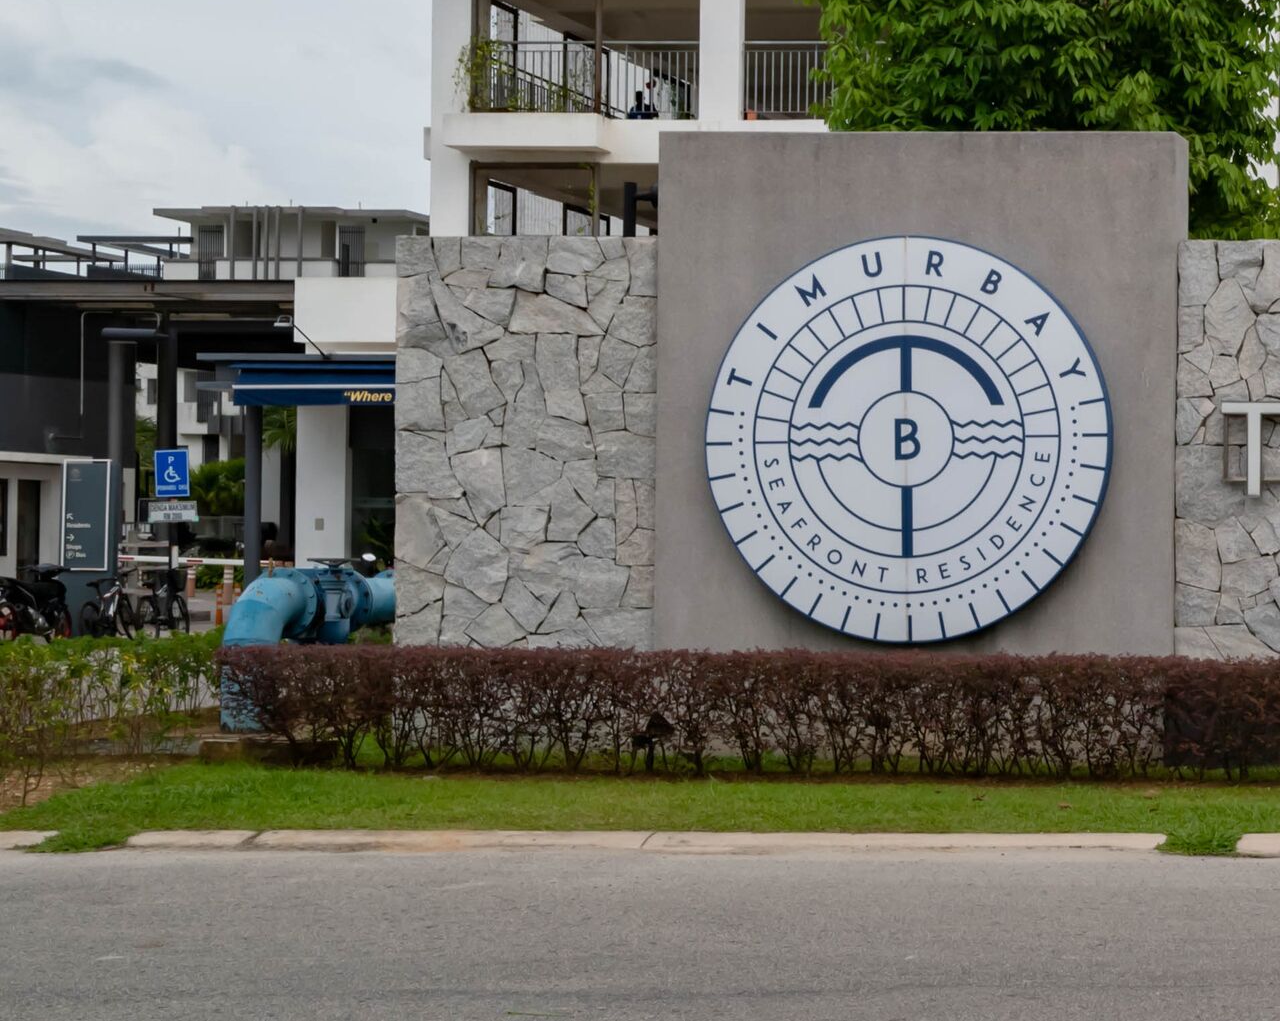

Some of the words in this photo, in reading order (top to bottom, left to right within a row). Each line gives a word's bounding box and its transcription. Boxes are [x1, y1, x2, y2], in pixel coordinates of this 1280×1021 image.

[727, 250, 1086, 387] TIMURBAY
[168, 455, 175, 464] P
[894, 418, 921, 461] B
[764, 457, 889, 583] SEAFRONT
[916, 451, 1051, 584] RESIDENCE
